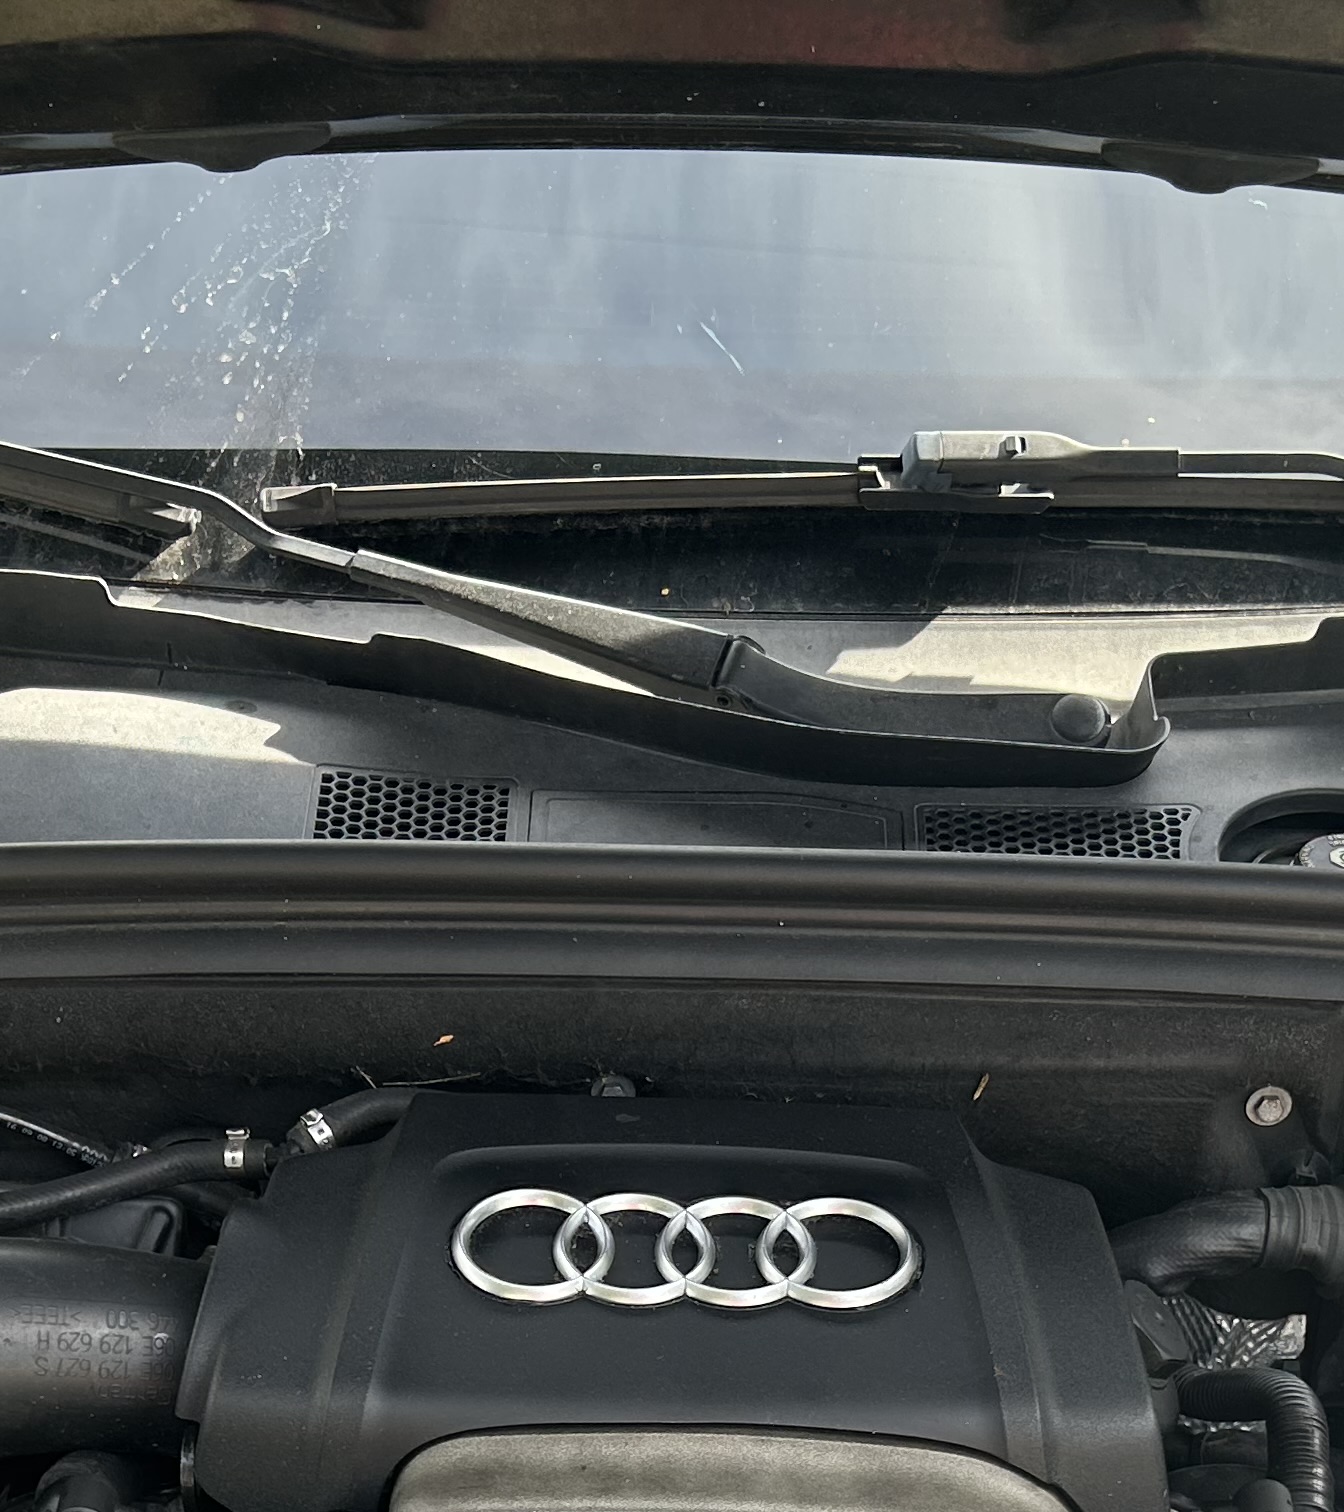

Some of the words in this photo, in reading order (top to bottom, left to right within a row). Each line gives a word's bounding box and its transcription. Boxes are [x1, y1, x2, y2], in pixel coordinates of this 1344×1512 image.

[36, 1330, 50, 1351] H
[57, 1332, 93, 1353] 629
[99, 1334, 133, 1355] 129
[34, 1356, 49, 1376] S
[56, 1357, 92, 1378] 627
[97, 1359, 132, 1380] 129
